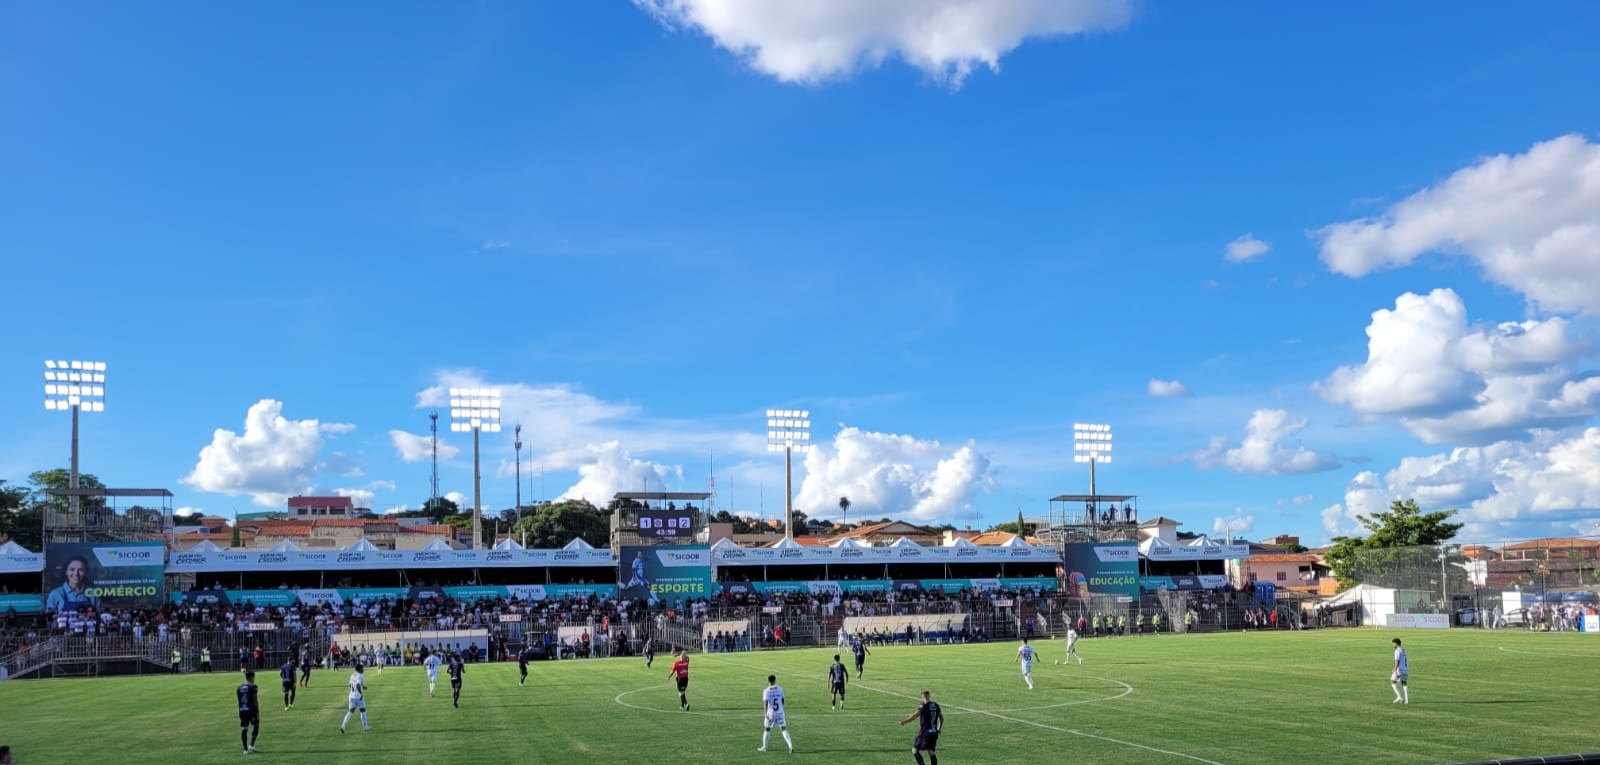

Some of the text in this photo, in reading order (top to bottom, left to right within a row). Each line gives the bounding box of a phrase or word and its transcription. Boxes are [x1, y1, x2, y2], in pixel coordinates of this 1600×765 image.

[643, 519, 688, 528] 1 2
[118, 551, 151, 560] SICOOB
[675, 553, 700, 561] SICOOB
[1090, 576, 1135, 587] EDUCAÇÃO
[84, 585, 157, 598] COMÉRCIO
[651, 583, 704, 594] ESPORTE
[773, 698, 779, 711] 5
